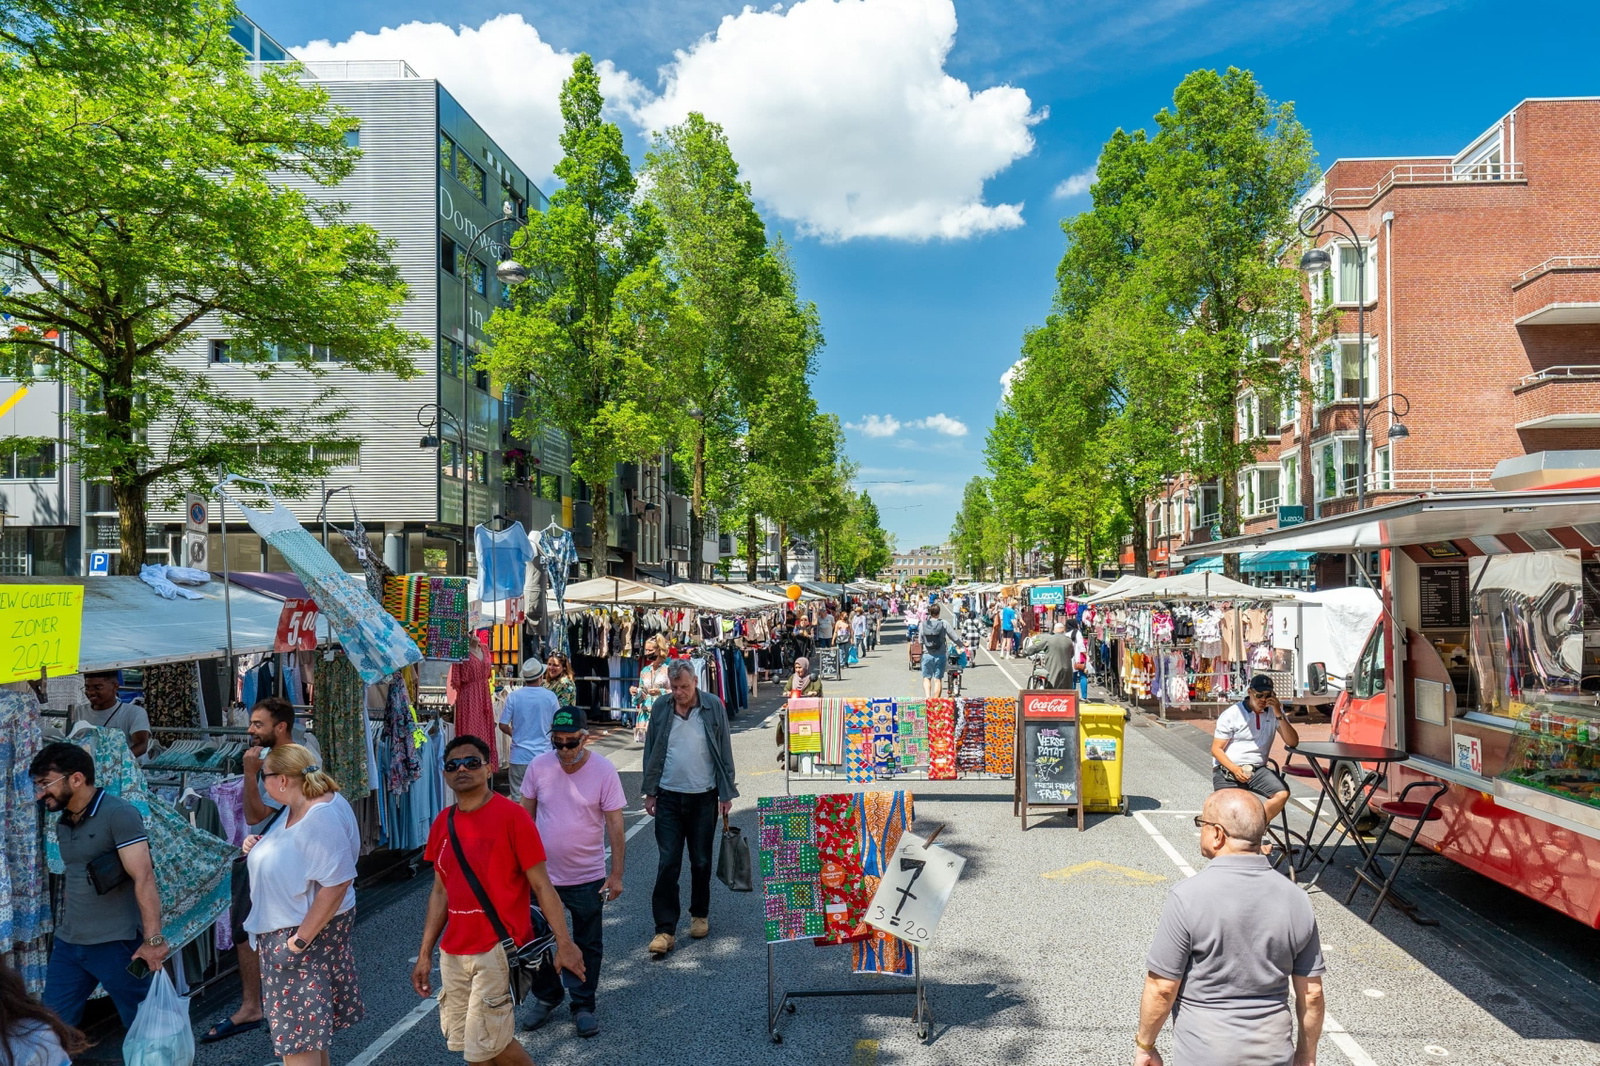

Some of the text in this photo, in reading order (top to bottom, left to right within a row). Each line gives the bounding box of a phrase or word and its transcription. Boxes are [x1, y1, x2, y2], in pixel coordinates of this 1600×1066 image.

[94, 555, 104, 569] P
[0, 591, 19, 609] EW
[11, 616, 58, 639] ZOMER
[12, 638, 63, 672] 2021
[1028, 698, 1070, 712] Coca-Cola
[1037, 732, 1065, 747] VERSE
[1037, 746, 1066, 758] PATAT
[896, 858, 926, 916] 7
